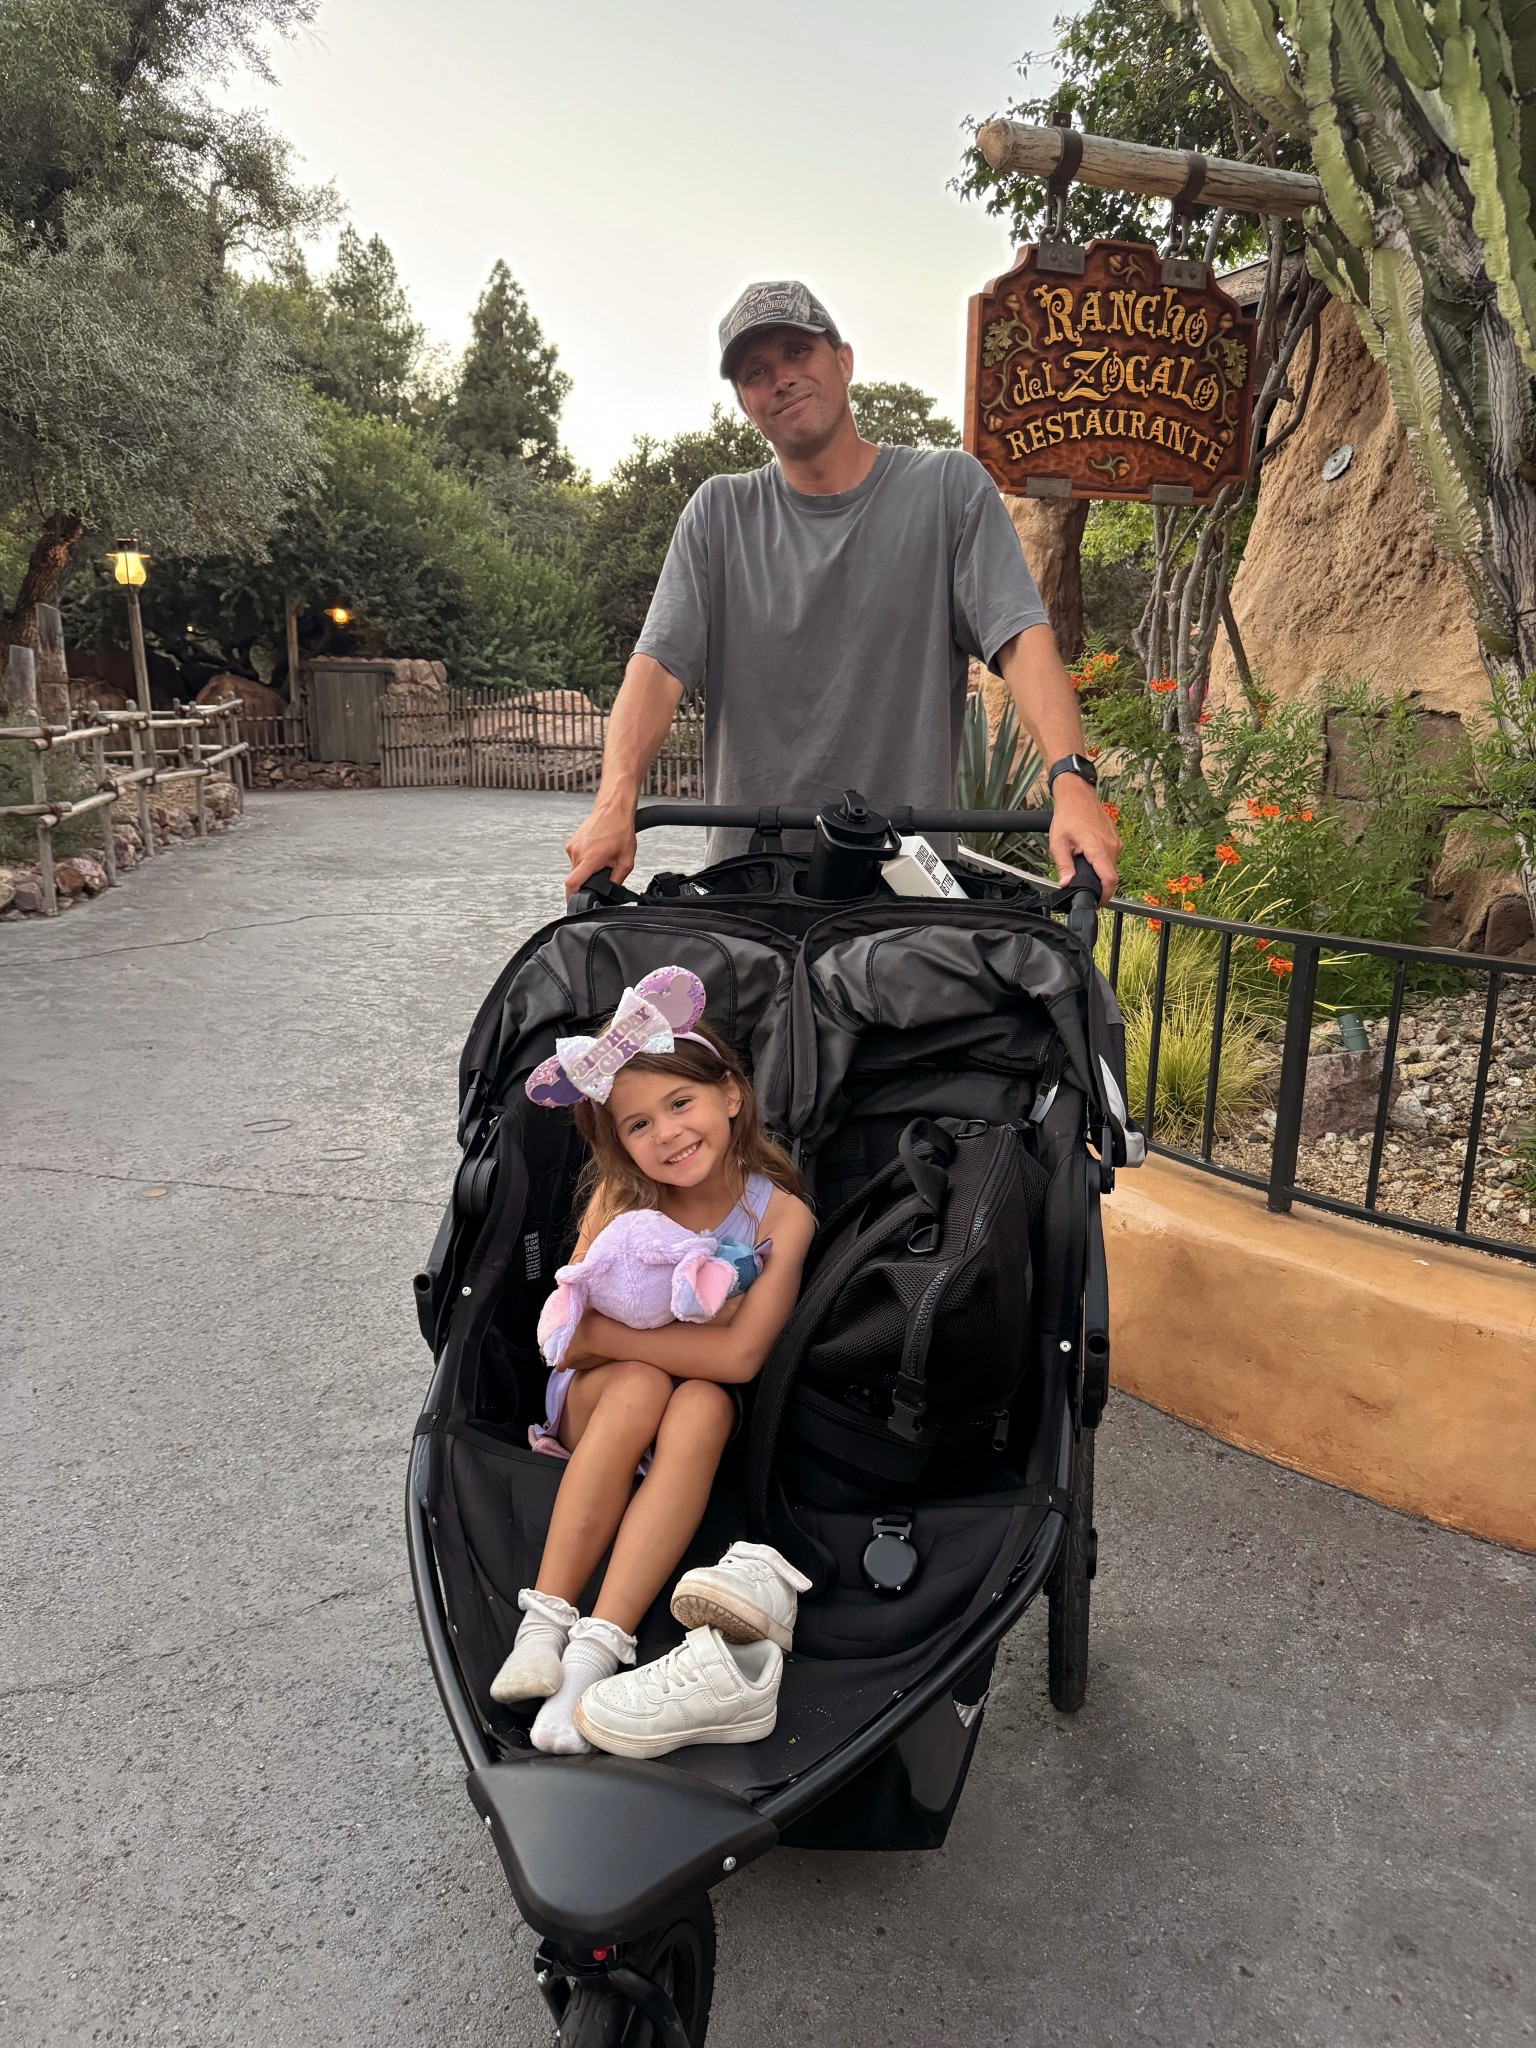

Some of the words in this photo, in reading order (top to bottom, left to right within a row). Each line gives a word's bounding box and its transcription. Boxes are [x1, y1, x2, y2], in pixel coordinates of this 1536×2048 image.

[1013, 361, 1056, 406] del
[1057, 347, 1219, 411] ZOCALO
[1006, 408, 1224, 472] RESTAURANTE
[574, 1006, 651, 1078] BIRTHDAY
[599, 1032, 648, 1074] GIRL
